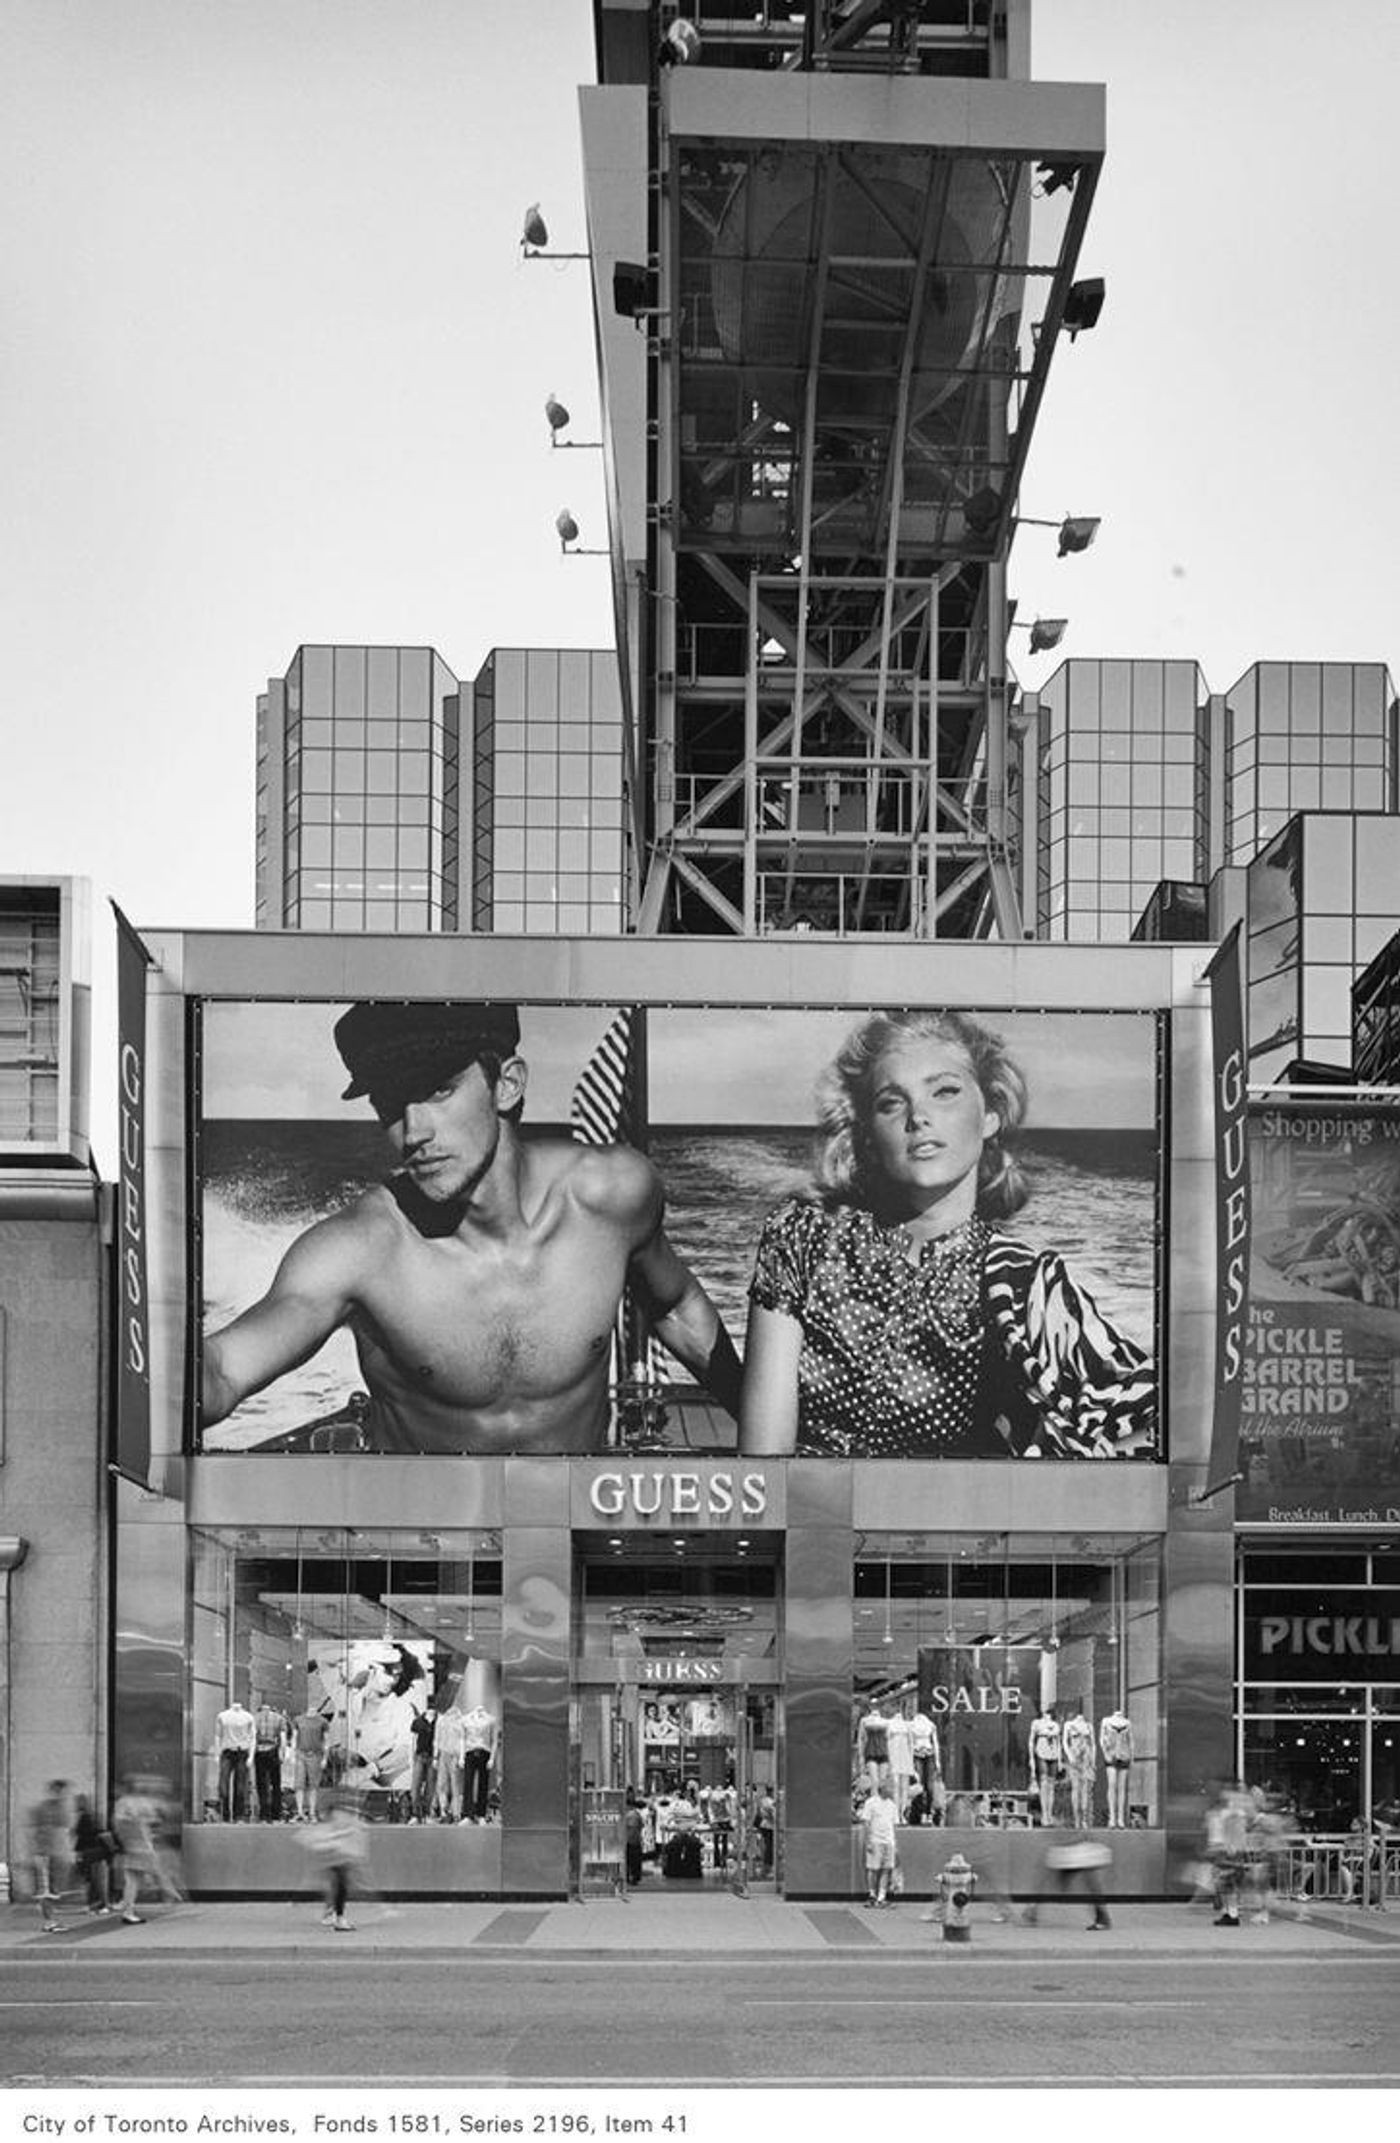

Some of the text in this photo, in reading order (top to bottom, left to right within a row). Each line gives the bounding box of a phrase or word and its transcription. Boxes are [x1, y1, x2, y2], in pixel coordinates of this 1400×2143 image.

[1262, 1110, 1374, 1145] Shopping
[121, 1043, 145, 1374] GUESS
[1222, 1049, 1247, 1383] GUESS
[1249, 1305, 1275, 1324] he
[590, 1472, 767, 1514] GUESS
[931, 1685, 1022, 1713] SALE
